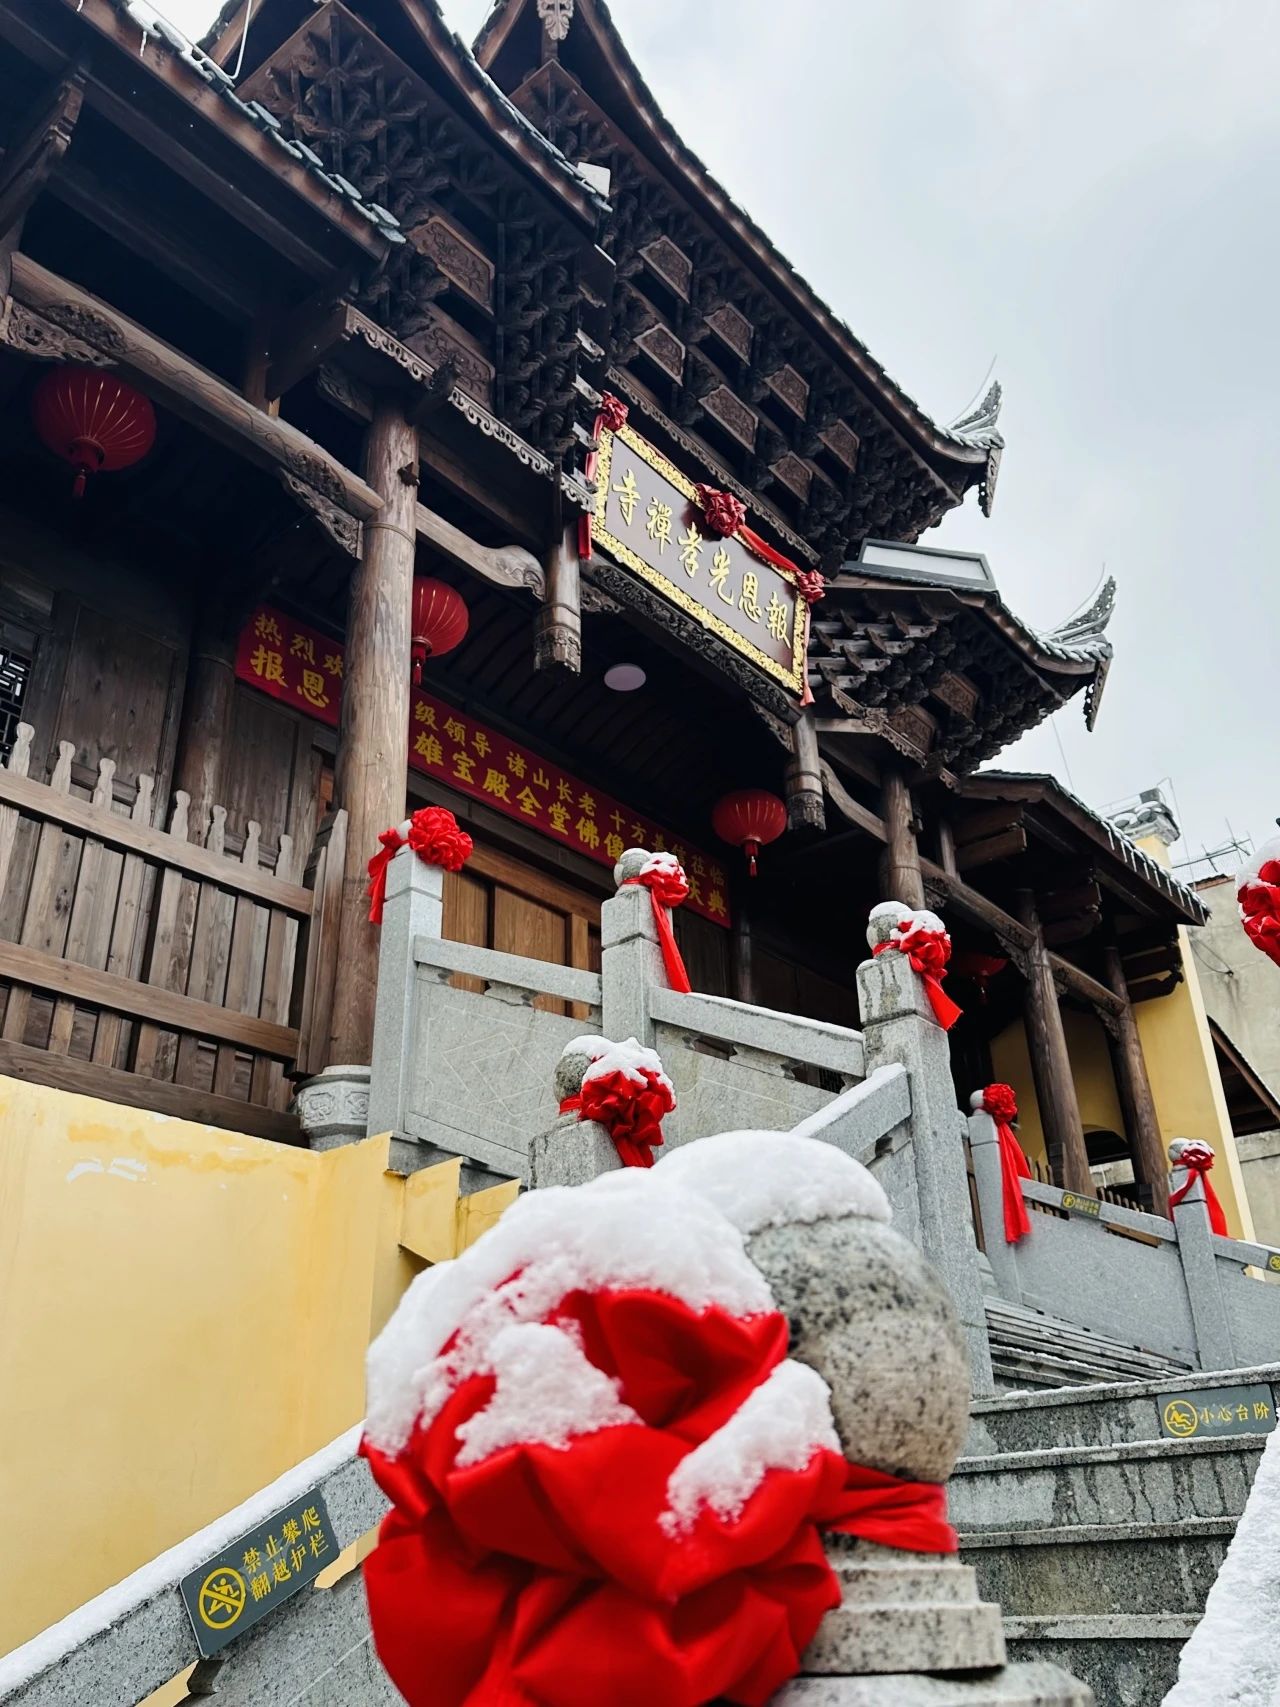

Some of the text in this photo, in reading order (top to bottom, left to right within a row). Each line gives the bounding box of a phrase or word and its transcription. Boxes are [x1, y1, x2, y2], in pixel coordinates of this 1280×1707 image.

[250, 644, 330, 708] 报恩
[255, 613, 343, 678] 热烈欢
[1200, 1401, 1270, 1424] 小心台阶
[242, 1506, 321, 1573] 禁止攀爬
[250, 1529, 329, 1602] 翻越护栏
